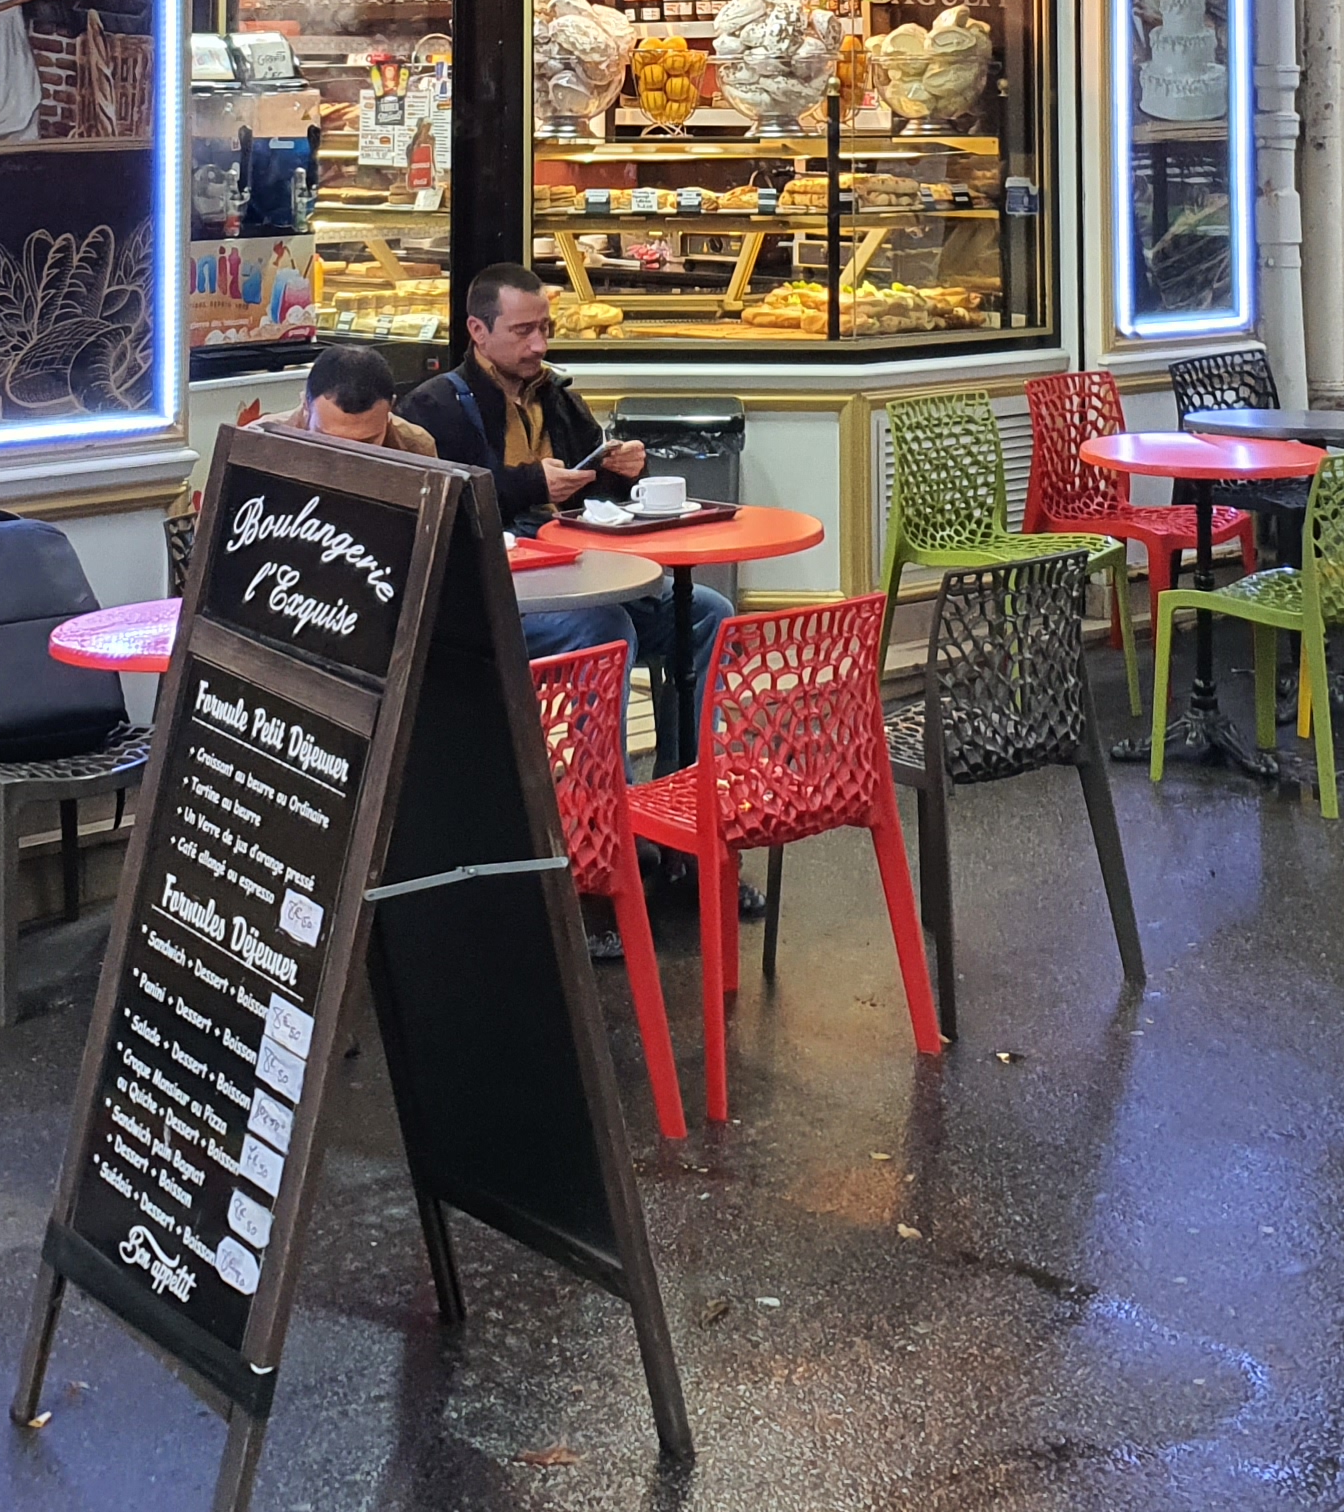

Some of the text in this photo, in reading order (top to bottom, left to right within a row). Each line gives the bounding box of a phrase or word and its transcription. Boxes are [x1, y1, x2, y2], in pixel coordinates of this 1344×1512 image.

[227, 495, 394, 602] Boulangerie
[244, 561, 358, 636] l'Exquise
[195, 679, 350, 782] Formule Petit Déjeuner
[191, 775, 221, 804] Tartine
[221, 796, 232, 811] au
[233, 799, 262, 827] beurre
[196, 747, 234, 777] Croissant
[234, 769, 246, 784] au
[246, 772, 275, 799] beurre
[276, 791, 288, 806] ou
[288, 795, 330, 829] Ordinaire
[177, 837, 198, 859] Café
[198, 850, 227, 878] allongé
[226, 868, 238, 883] ou
[238, 875, 275, 904] espresso
[183, 806, 196, 825] Un
[197, 813, 221, 838] Verre
[222, 828, 234, 846] de
[232, 835, 248, 854] jus
[249, 843, 284, 875] d'orange
[284, 866, 315, 892] pressé
[148, 930, 187, 968] Sandwich
[194, 958, 229, 994] Dessert
[162, 873, 298, 986] Formules Déjeuner
[139, 972, 167, 1002] Panini
[175, 996, 212, 1033] Dessert
[222, 1028, 257, 1065] Boisson
[123, 1048, 228, 1136] Croque Monsieur ou Pizza
[131, 1015, 161, 1047] Salade
[171, 1041, 208, 1079] Dessert
[216, 1072, 251, 1111] Boisson
[112, 1105, 205, 1186] Sandwich pain Bagnat
[116, 1076, 128, 1092] ou
[129, 1081, 157, 1115] Quiche
[165, 1107, 200, 1145] Dessert
[207, 1138, 240, 1176] Boisson
[100, 1162, 133, 1199] Suédois
[139, 1192, 176, 1232] Dessert
[182, 1226, 216, 1267] Boisson
[114, 1134, 149, 1173] Dessert
[158, 1168, 193, 1209] Boisson
[119, 1225, 174, 1271] Bon
